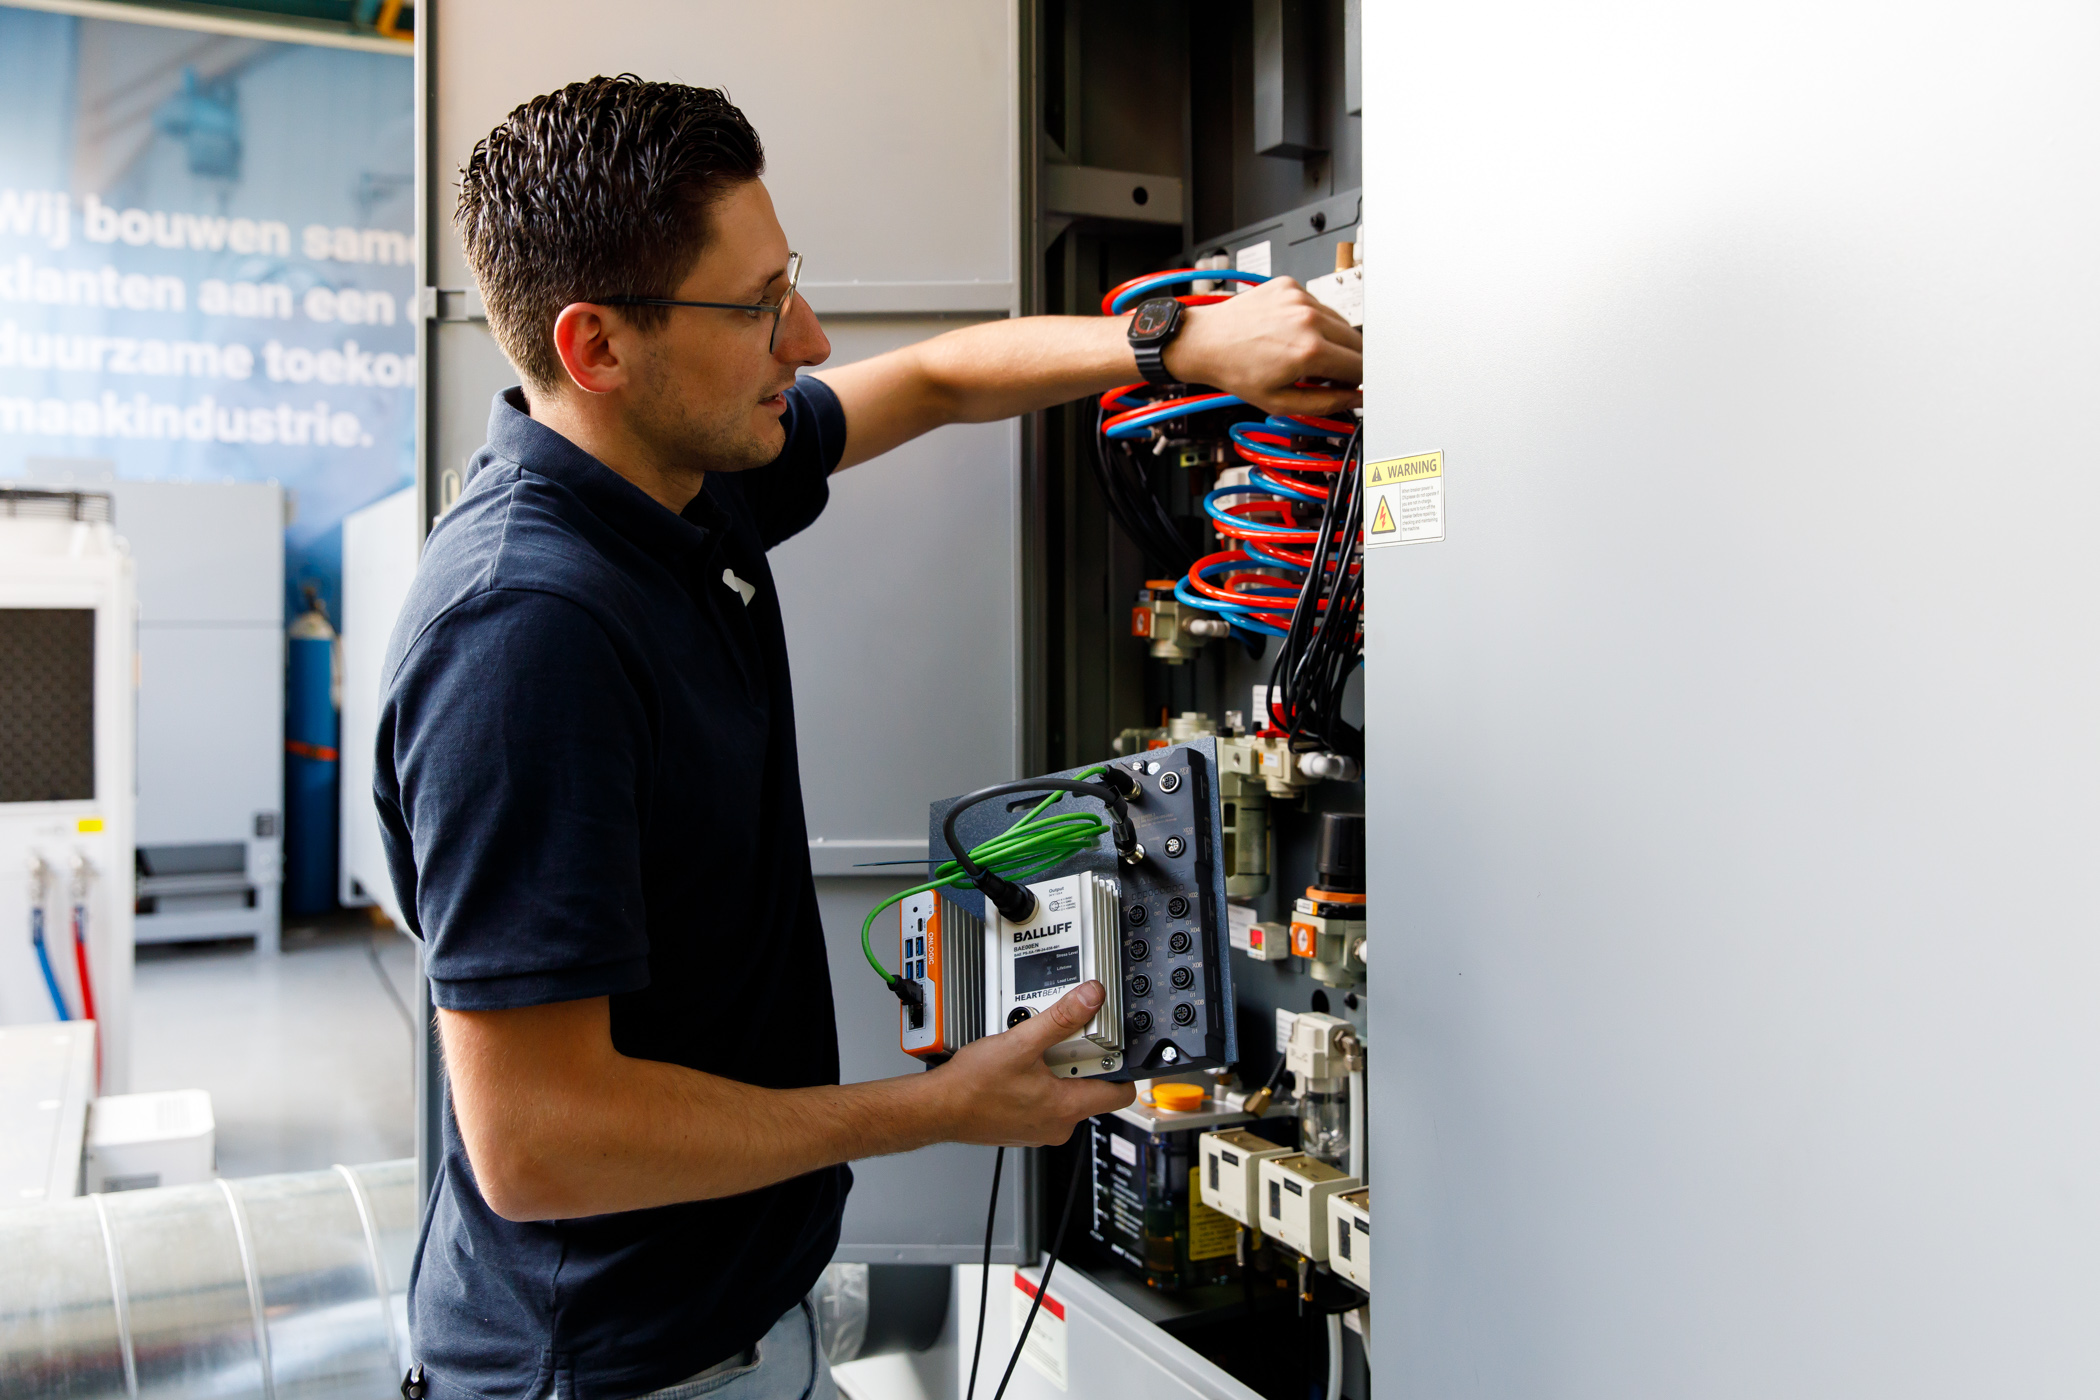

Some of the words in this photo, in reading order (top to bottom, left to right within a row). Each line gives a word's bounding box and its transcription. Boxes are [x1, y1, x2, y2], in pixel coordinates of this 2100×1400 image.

[83, 193, 291, 258] bouwen
[197, 278, 294, 320] aan
[303, 285, 396, 327] een
[0, 320, 254, 381] duurzame
[0, 390, 374, 449] maakindustrie.
[1387, 458, 1437, 478] WARNING
[1014, 922, 1072, 943] BALLUFF
